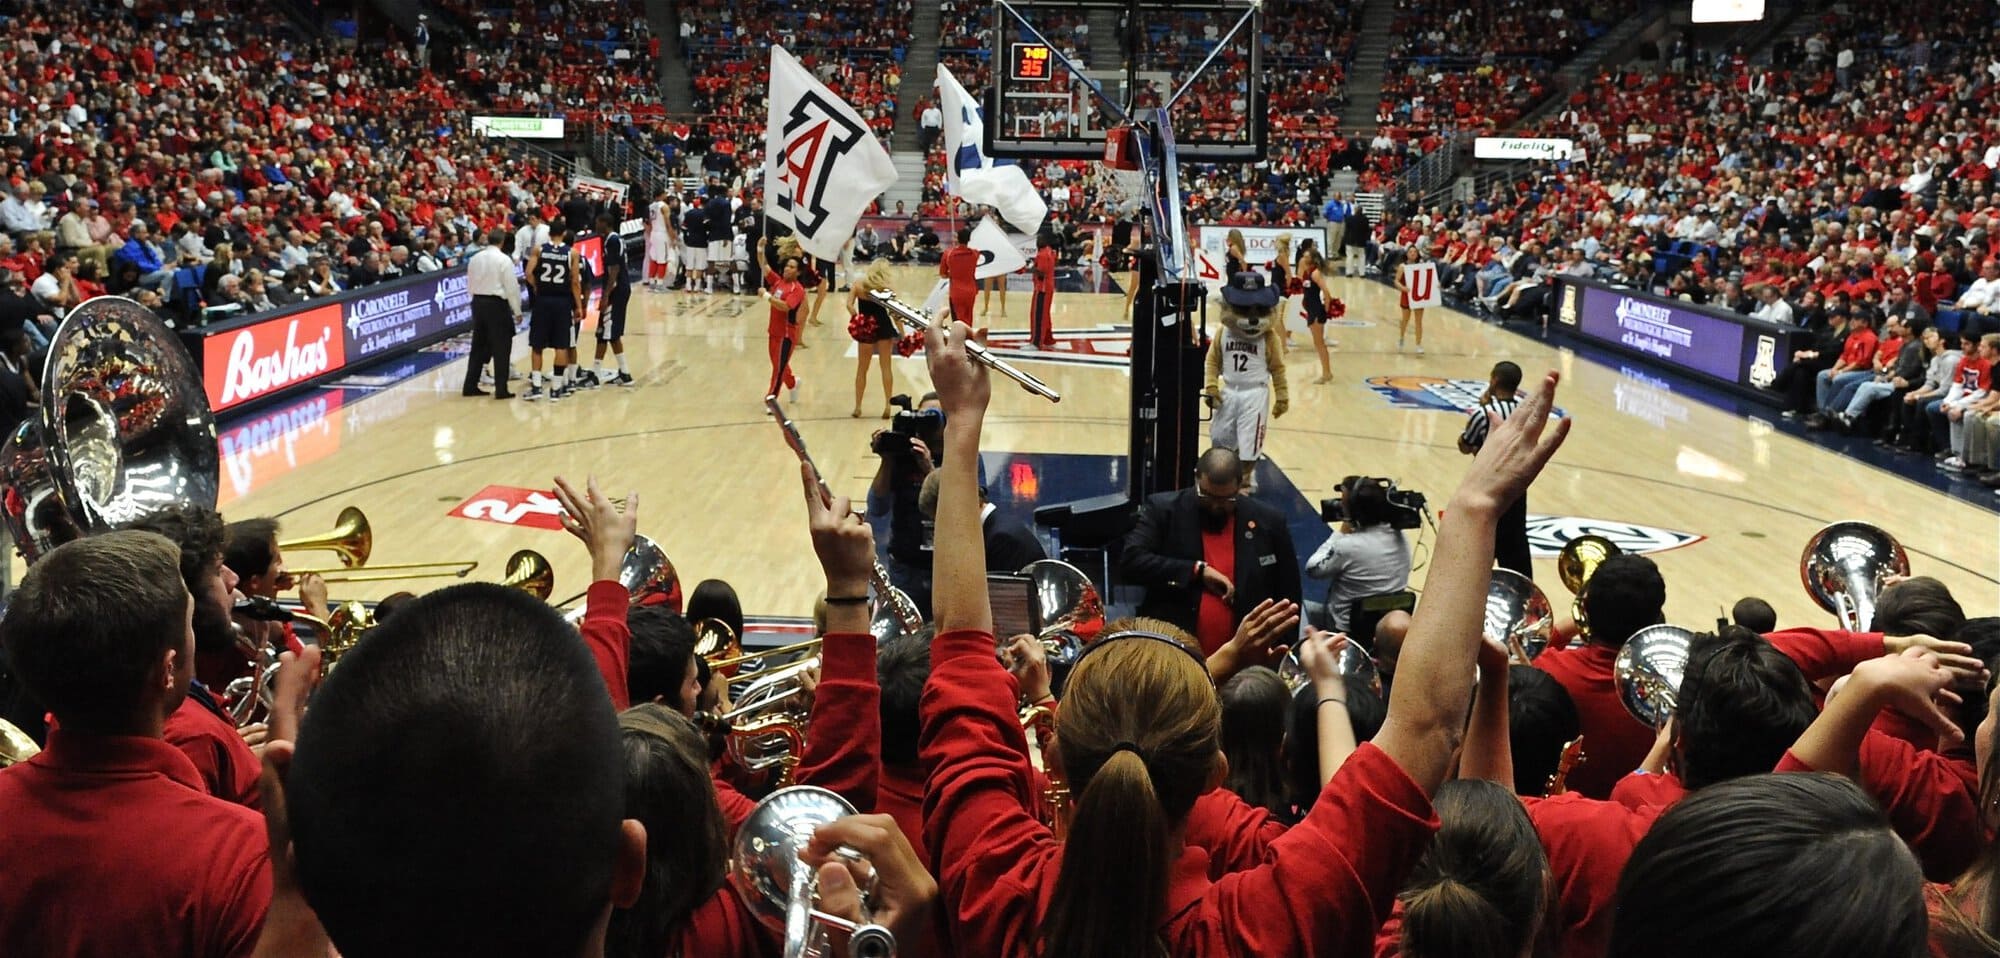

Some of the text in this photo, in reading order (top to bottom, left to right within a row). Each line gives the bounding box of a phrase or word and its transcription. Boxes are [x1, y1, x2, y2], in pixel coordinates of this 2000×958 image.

[1020, 60, 1043, 76] 35
[540, 262, 566, 283] 22
[1412, 268, 1433, 302] U
[357, 290, 409, 318] CARONDELET
[1226, 341, 1258, 355] ARIZONA
[221, 320, 331, 404] Bashas'
[1233, 354, 1249, 372] 12
